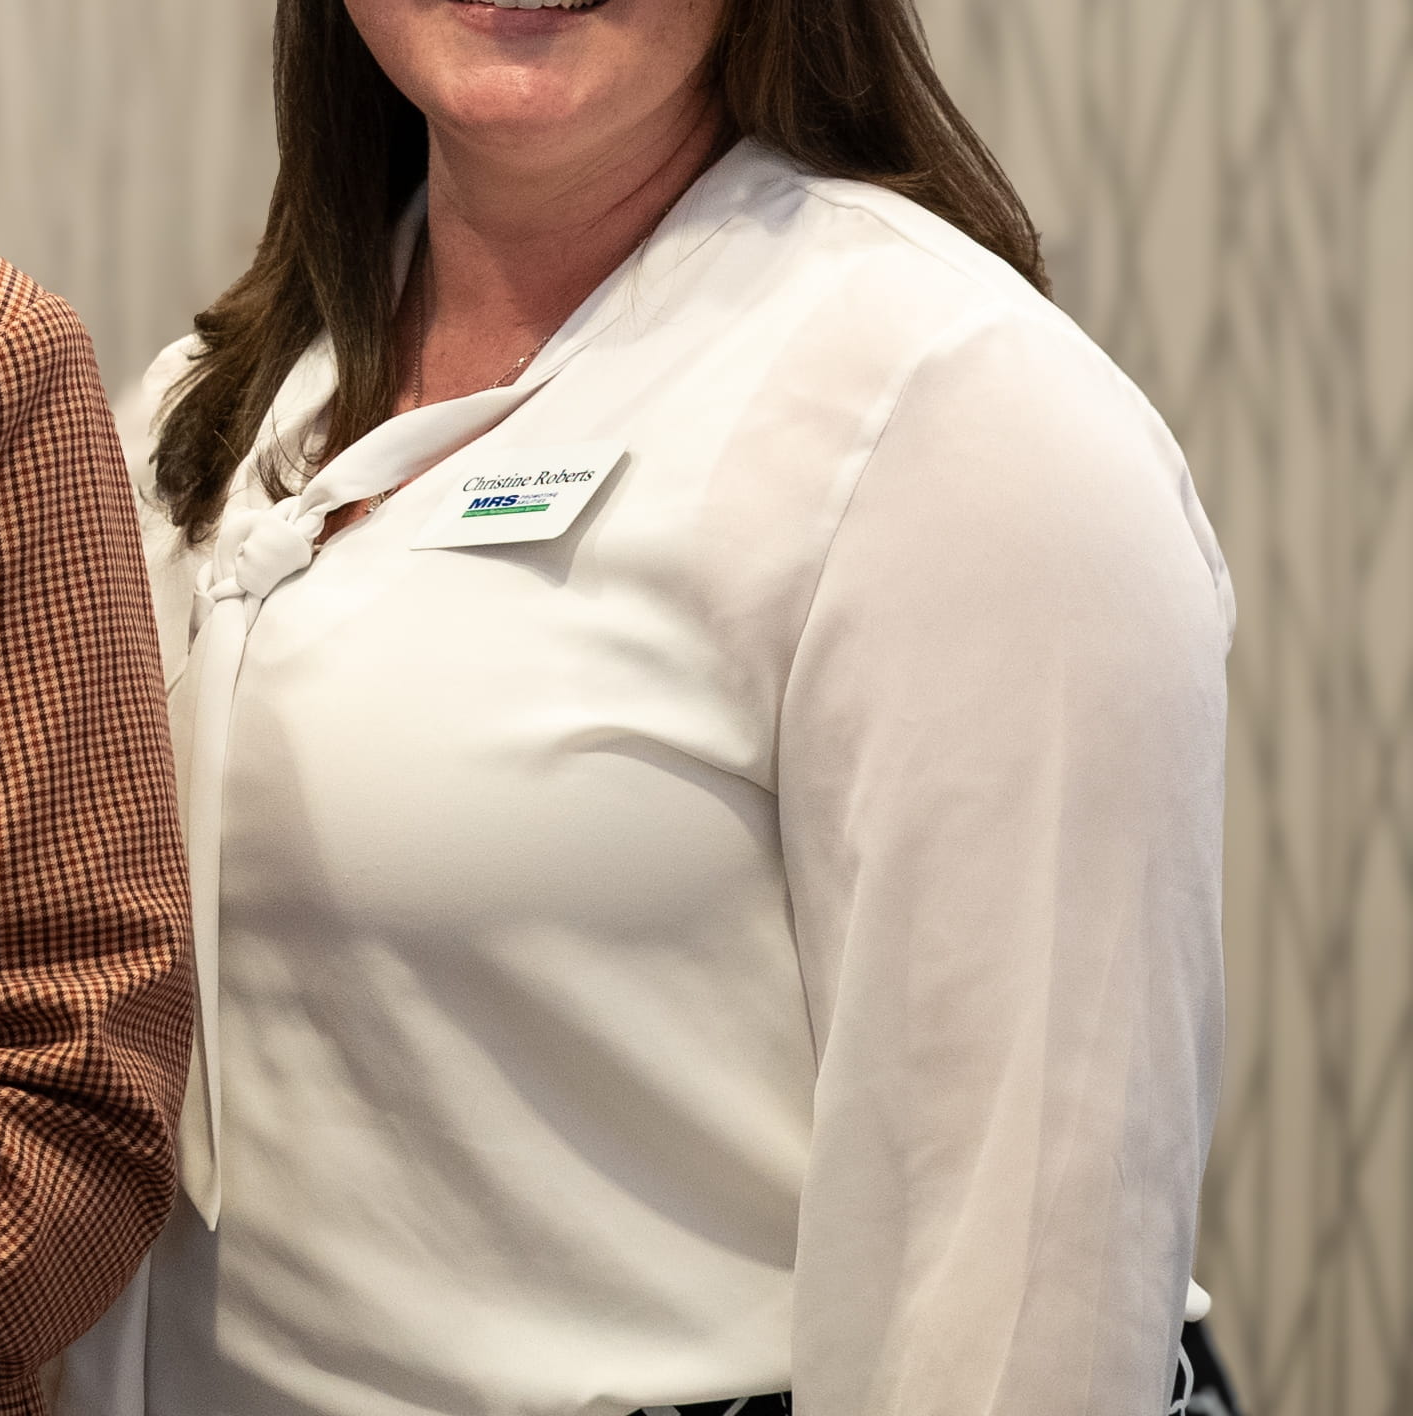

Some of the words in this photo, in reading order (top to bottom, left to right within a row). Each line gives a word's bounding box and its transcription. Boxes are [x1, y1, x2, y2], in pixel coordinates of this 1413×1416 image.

[462, 472, 532, 492] Christine
[533, 468, 595, 486] Roberts
[468, 494, 520, 509] MRS
